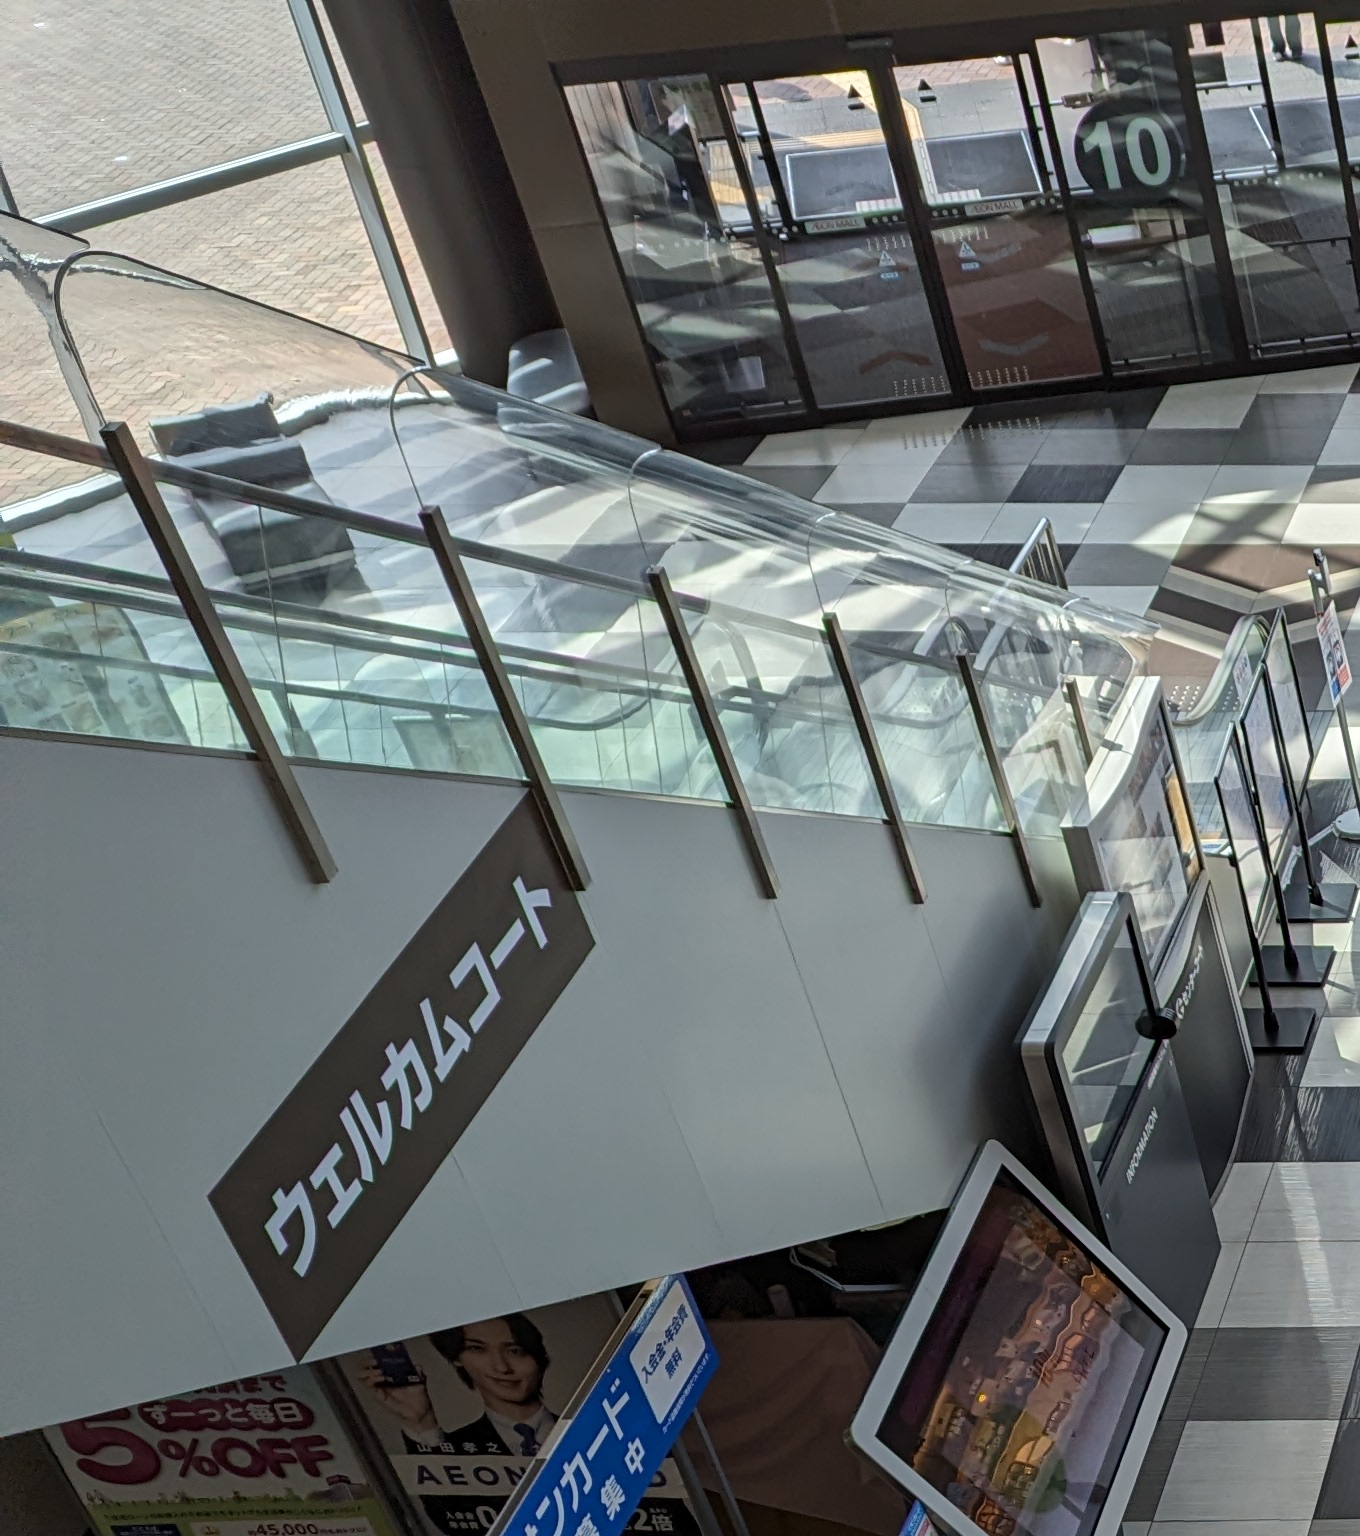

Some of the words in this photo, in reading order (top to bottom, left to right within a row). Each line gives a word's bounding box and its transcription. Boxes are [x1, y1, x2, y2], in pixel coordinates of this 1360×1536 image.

[1083, 117, 1172, 190] 10
[264, 876, 553, 1278] ウェルカムコート
[1126, 1106, 1160, 1184] INFORMATION
[663, 1346, 683, 1380] 無料
[142, 1400, 305, 1425] ずーっと毎日
